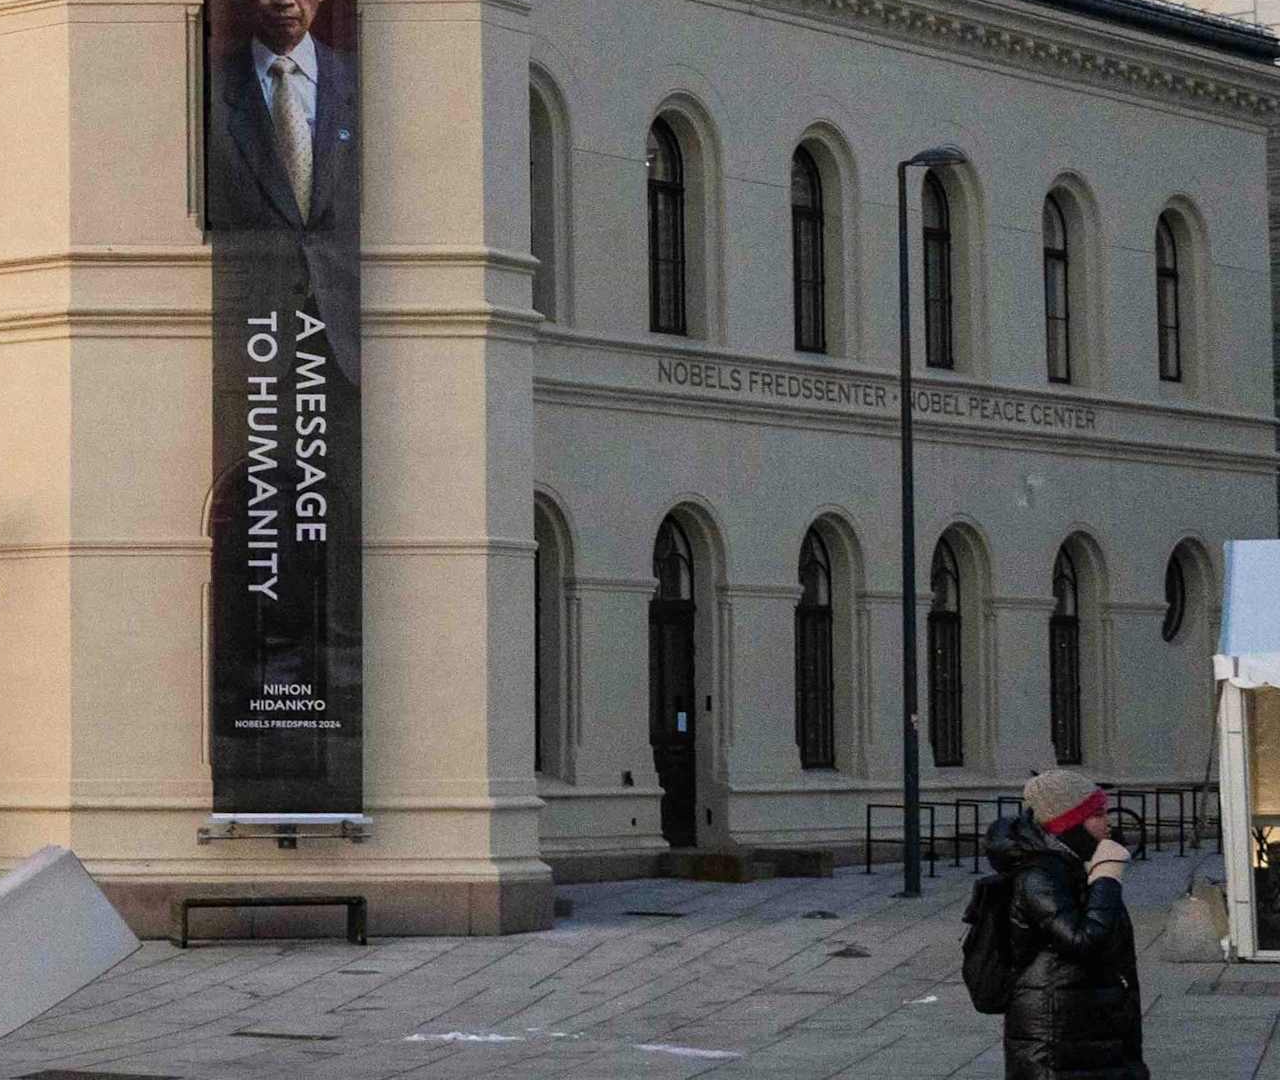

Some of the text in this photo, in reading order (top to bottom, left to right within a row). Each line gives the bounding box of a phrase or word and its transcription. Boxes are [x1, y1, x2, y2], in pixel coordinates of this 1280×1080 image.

[657, 359, 742, 392] NOBELS
[748, 371, 887, 408] FREDSSENTER
[969, 397, 1027, 423] PEACE
[1030, 403, 1096, 430] CENTER
[295, 310, 327, 542] A MESSAGE
[246, 311, 278, 601] TO HUMANITY
[249, 699, 326, 711] HIDANKYO
[263, 684, 312, 696] NIHON
[235, 720, 342, 728] NOBELS FREDSPRIS 2024
